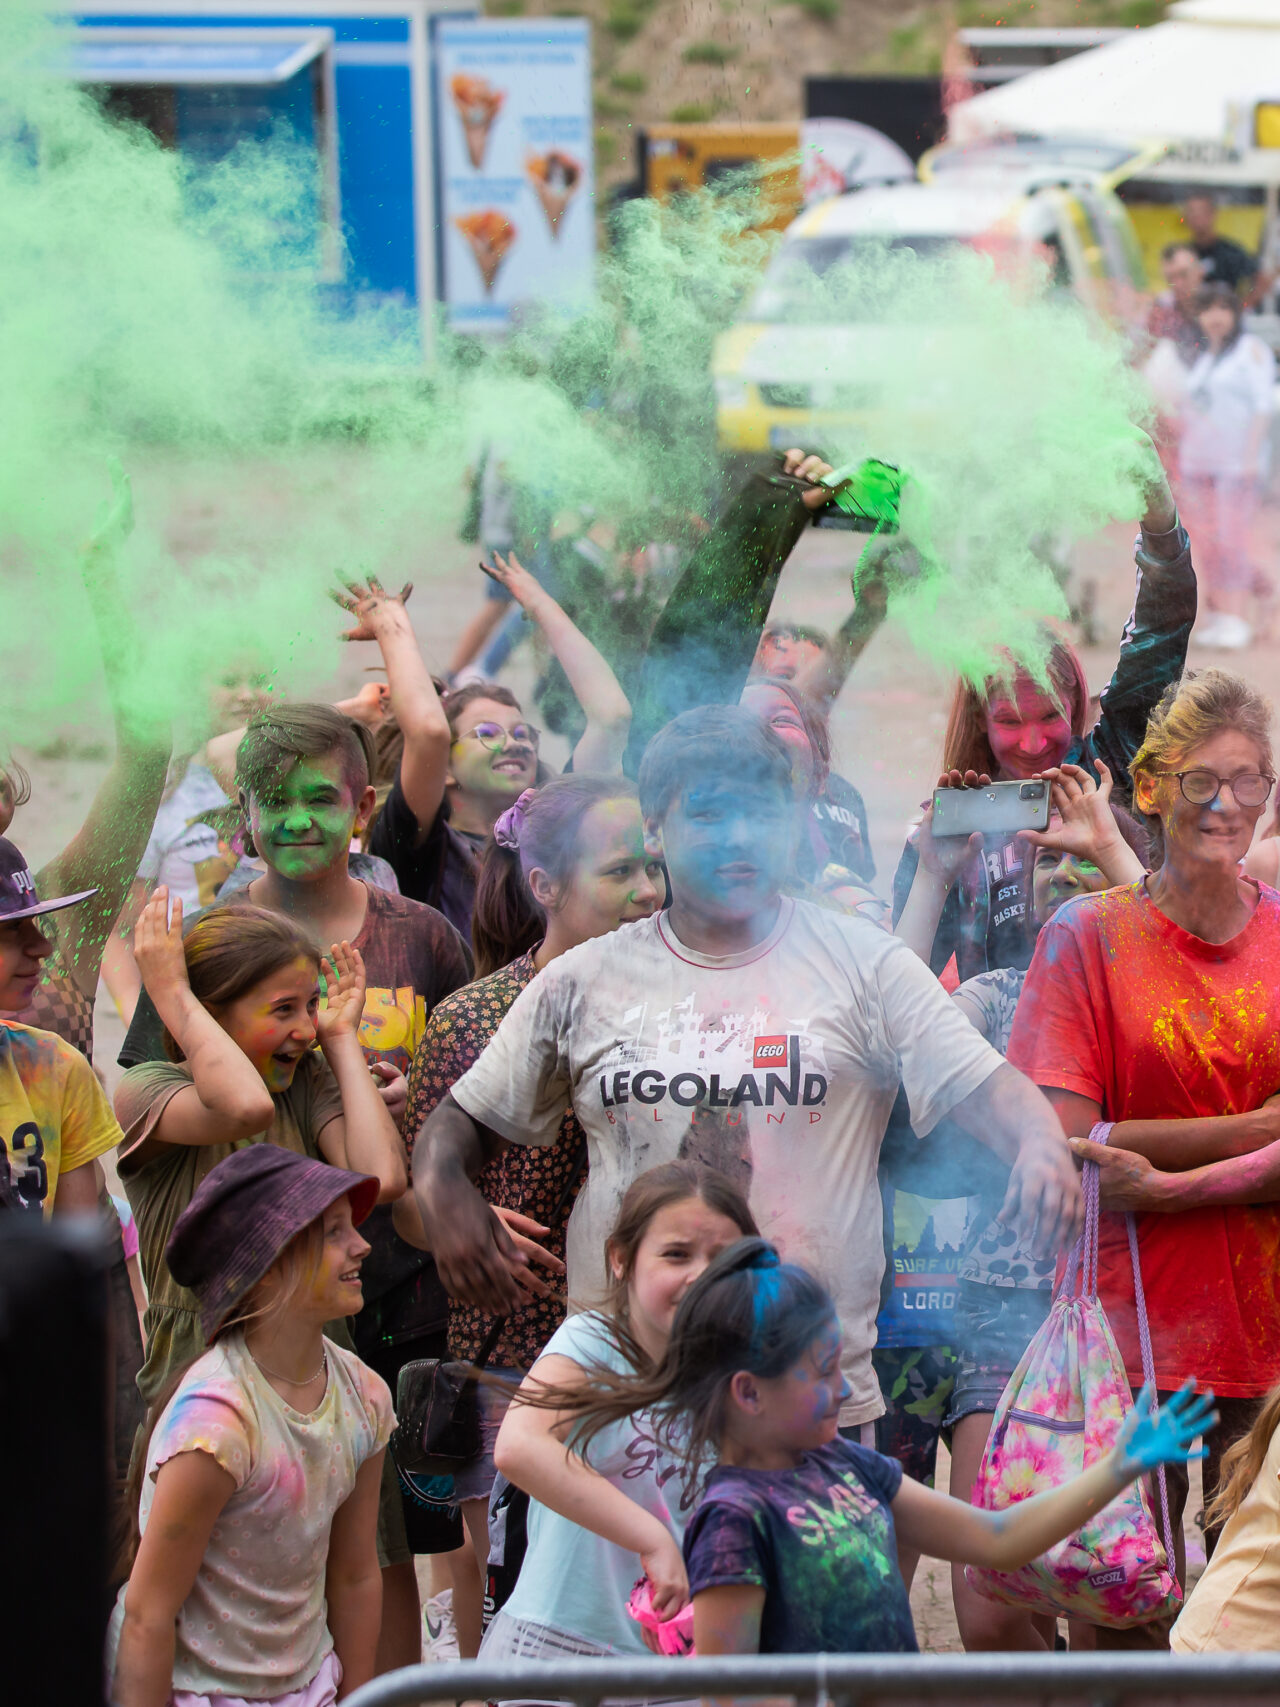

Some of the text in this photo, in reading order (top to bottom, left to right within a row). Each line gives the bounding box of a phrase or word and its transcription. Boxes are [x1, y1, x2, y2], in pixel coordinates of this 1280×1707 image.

[998, 884, 1021, 901] EST.
[756, 1044, 785, 1058] LEGO
[600, 1035, 828, 1107] LEGOLAND
[605, 1108, 822, 1126] BILLUND
[894, 1258, 939, 1273] SURF
